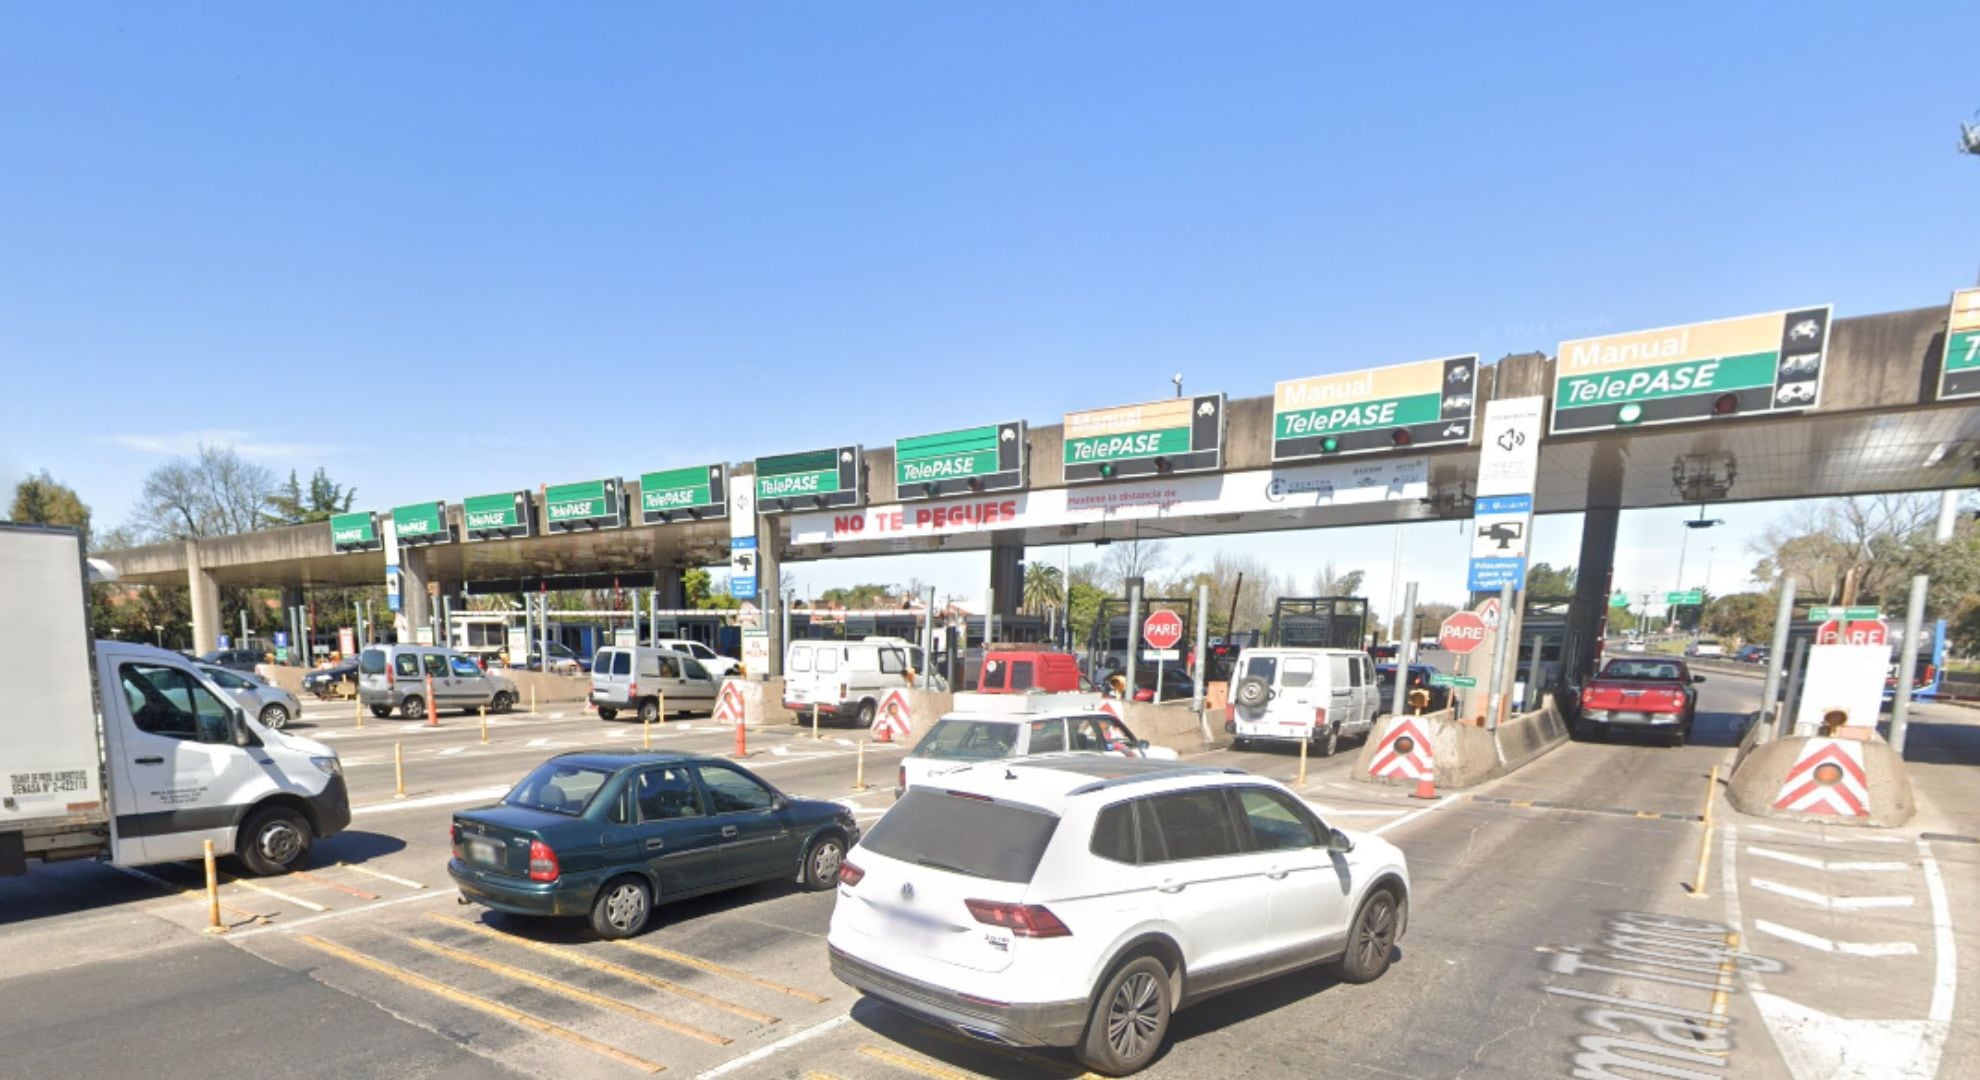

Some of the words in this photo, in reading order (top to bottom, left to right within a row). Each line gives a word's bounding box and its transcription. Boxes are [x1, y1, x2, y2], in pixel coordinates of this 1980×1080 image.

[1571, 329, 1690, 369] Manual
[1285, 372, 1374, 405] Manual
[1568, 362, 1720, 402] TelePASE
[1284, 402, 1398, 434] TelePASE
[1073, 433, 1162, 459] TelePASE
[903, 457, 975, 480] TelePASE
[761, 475, 819, 494] TelePASE
[550, 502, 592, 518] TelePASE
[645, 490, 694, 507] TelePASE
[834, 514, 865, 534] NO
[876, 512, 904, 532] TE
[916, 500, 1016, 529] PEGUES
[1147, 623, 1179, 637] PARE
[1443, 624, 1484, 640] PARE
